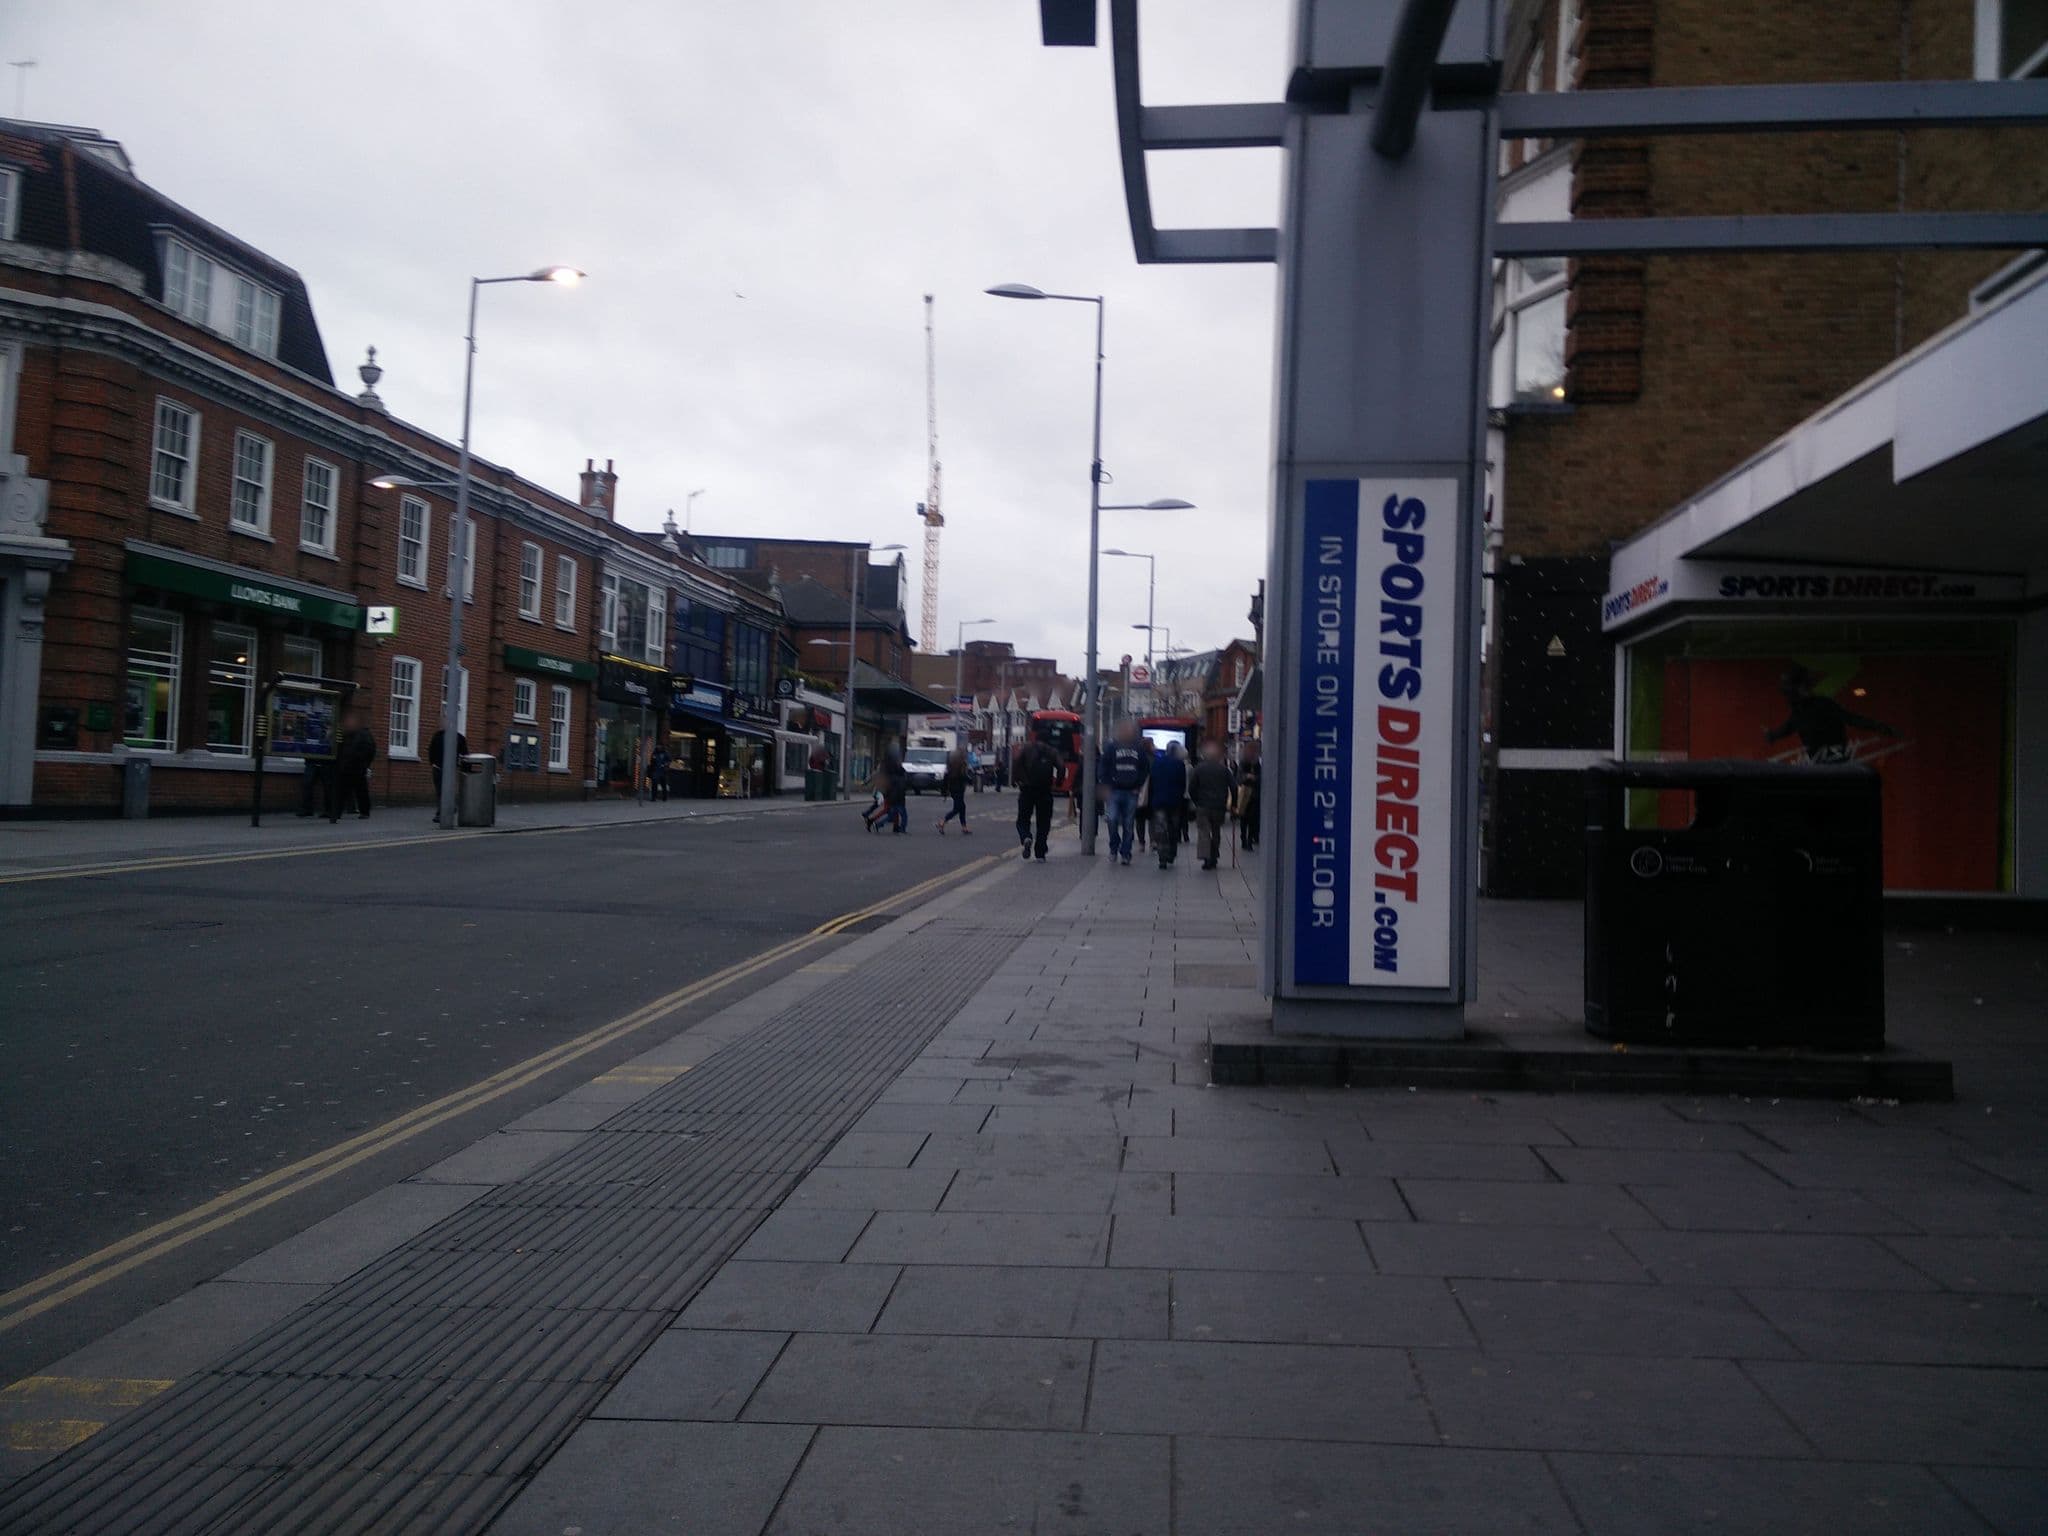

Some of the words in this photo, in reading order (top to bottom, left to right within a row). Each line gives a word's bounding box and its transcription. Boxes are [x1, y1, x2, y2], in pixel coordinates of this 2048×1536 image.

[1319, 535, 1342, 565] IN
[1317, 575, 1341, 665] STORE
[1315, 675, 1340, 717] ON
[1314, 727, 1337, 781] THE
[1312, 837, 1335, 928] FLOOR
